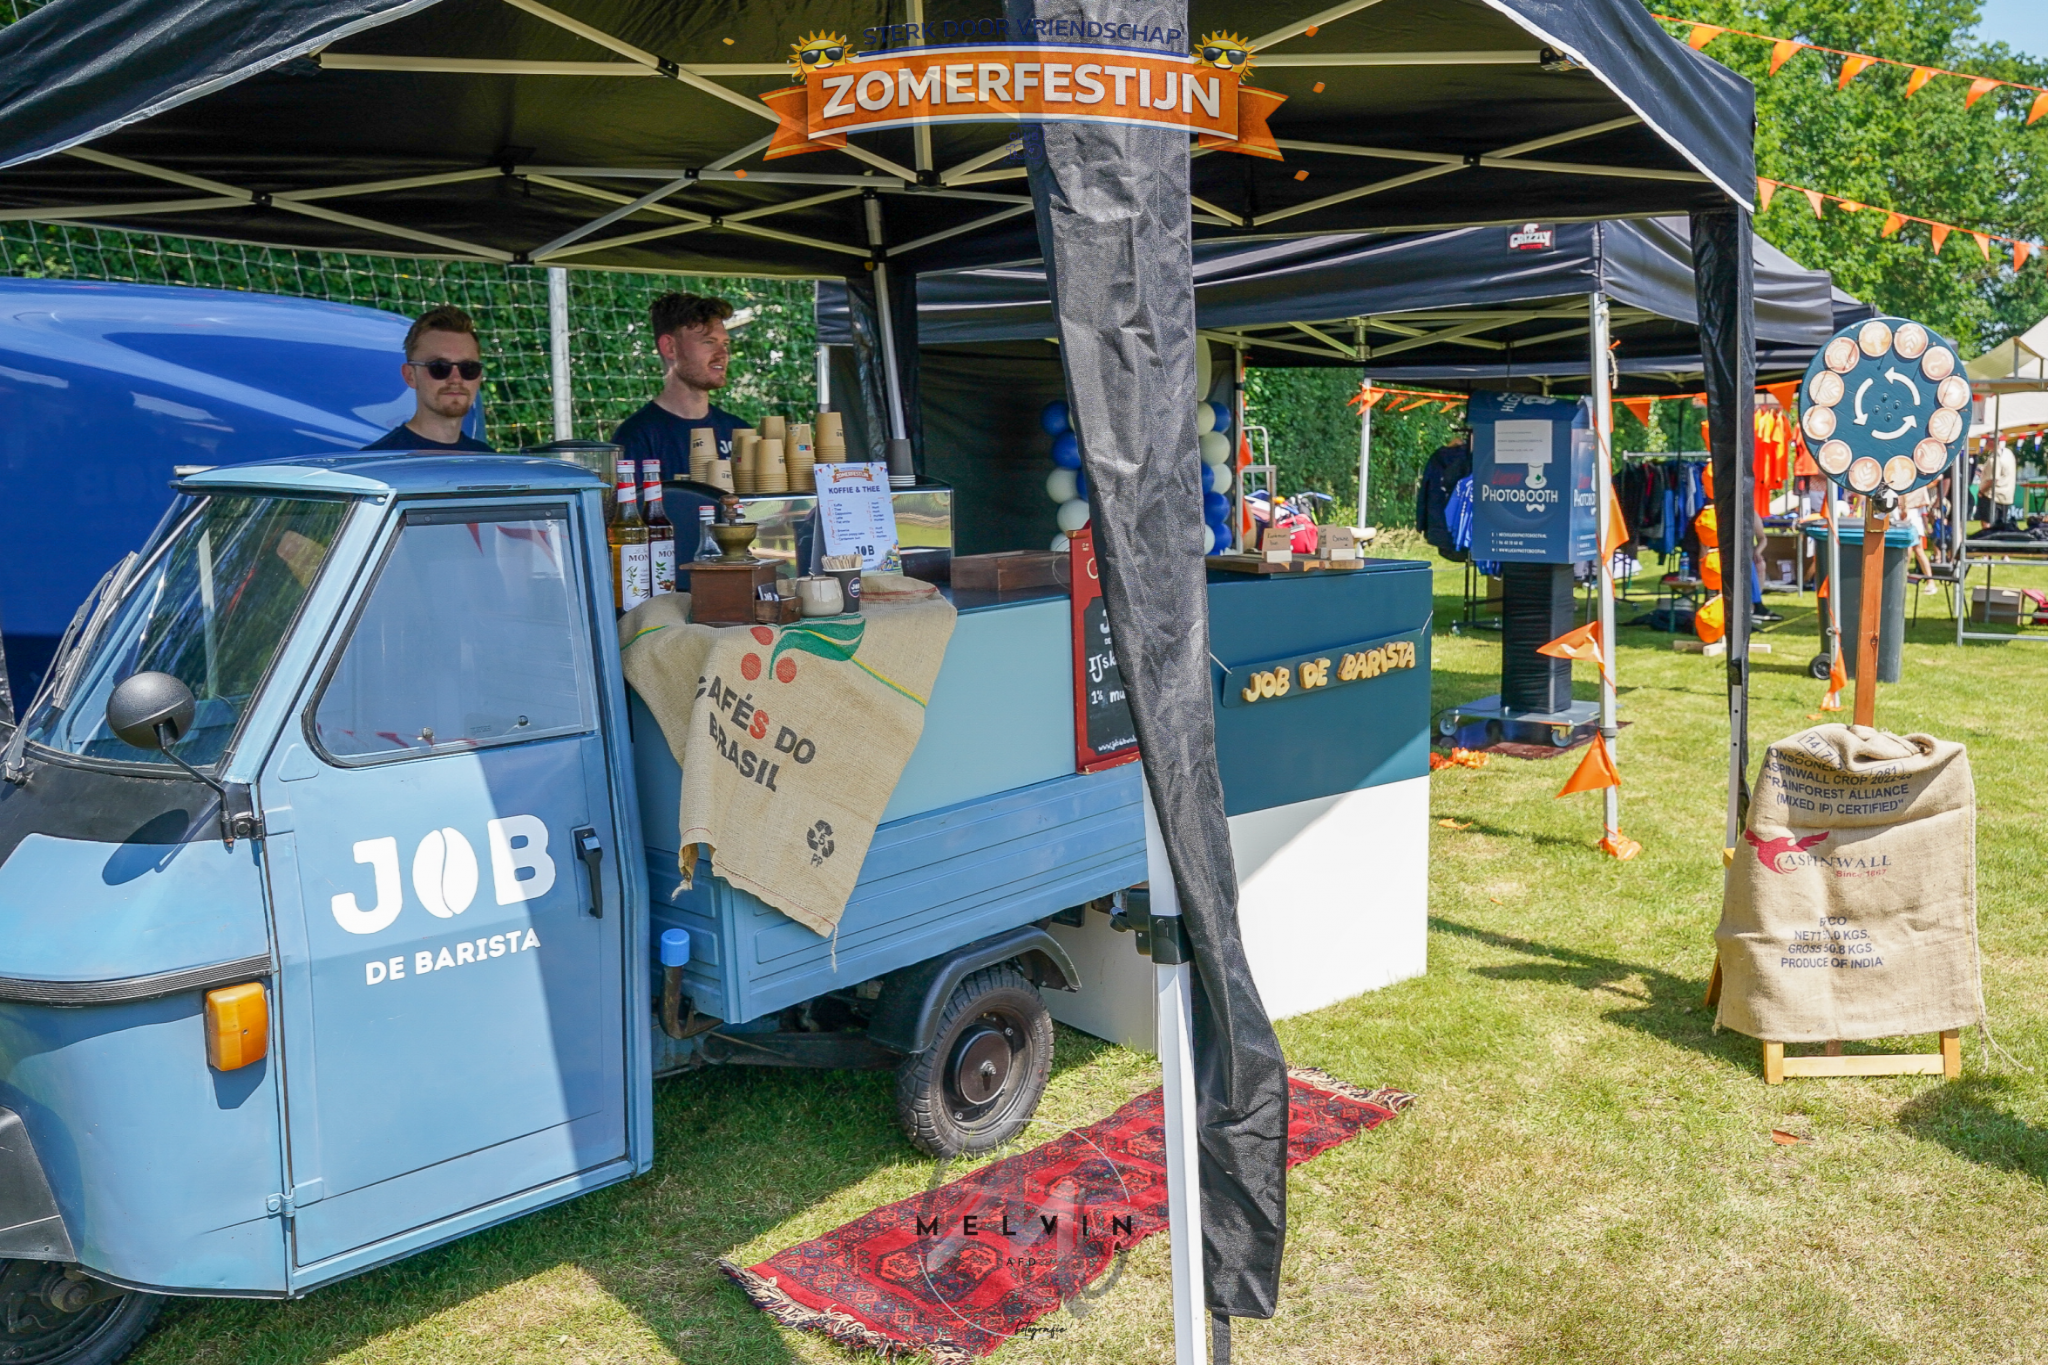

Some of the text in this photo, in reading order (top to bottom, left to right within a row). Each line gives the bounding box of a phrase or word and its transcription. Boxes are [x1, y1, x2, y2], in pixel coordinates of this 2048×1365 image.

[1509, 229, 1553, 249] GRIZZLY
[828, 486, 854, 495] KOFFIE
[862, 485, 881, 493] THEE
[1242, 641, 1415, 702] JOB DE BARISTA
[709, 711, 780, 792] BRASIL
[774, 725, 816, 764] DO
[1764, 760, 1829, 785] ASPINWALL
[1832, 774, 1868, 785] CROP
[1849, 783, 1909, 800] ALLIANCE
[1776, 794, 1816, 811] (MIXED
[1818, 803, 1833, 816] IP)
[816, 833, 826, 845] 5
[1784, 854, 1892, 869] ASPINWALL
[331, 814, 556, 934] JOB
[1795, 930, 1821, 941] NETT
[1843, 929, 1870, 940] KGS.
[365, 927, 541, 986] DE BARISTA
[1788, 944, 1822, 954] GROSS
[1823, 943, 1846, 954] 50.8
[1780, 956, 1883, 969] PRODUCE OF INDIA
